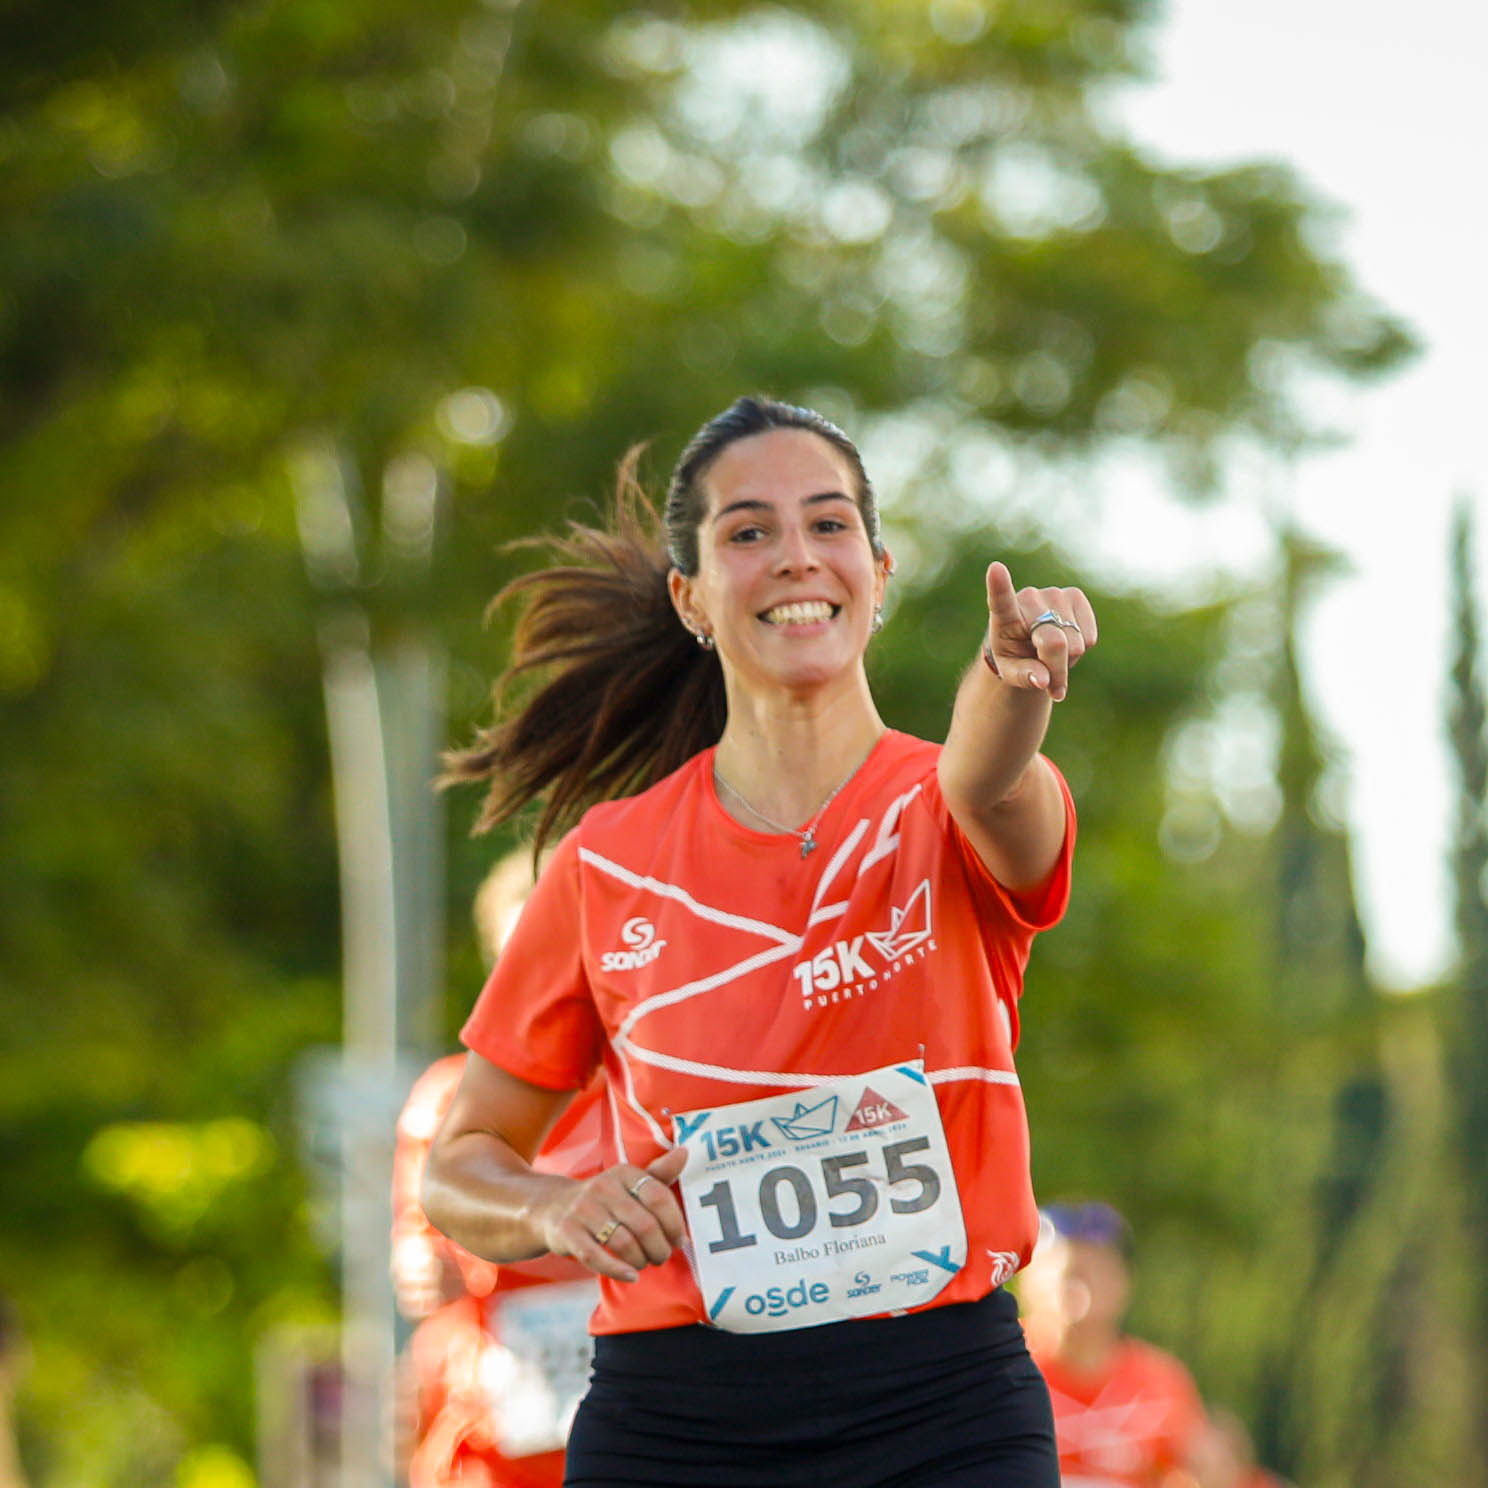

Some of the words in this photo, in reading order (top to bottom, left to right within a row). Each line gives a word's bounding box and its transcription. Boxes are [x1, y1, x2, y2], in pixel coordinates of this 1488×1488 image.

[793, 935, 876, 996] 15K
[802, 979, 878, 1011] PUERTO
[883, 939, 937, 981] NORTE
[856, 1102, 892, 1125] 15K
[700, 1119, 772, 1161] 15K
[699, 1136, 942, 1254] 1055
[774, 1247, 820, 1266] Balbo
[823, 1231, 887, 1257] Floriana
[745, 1279, 829, 1317] osde
